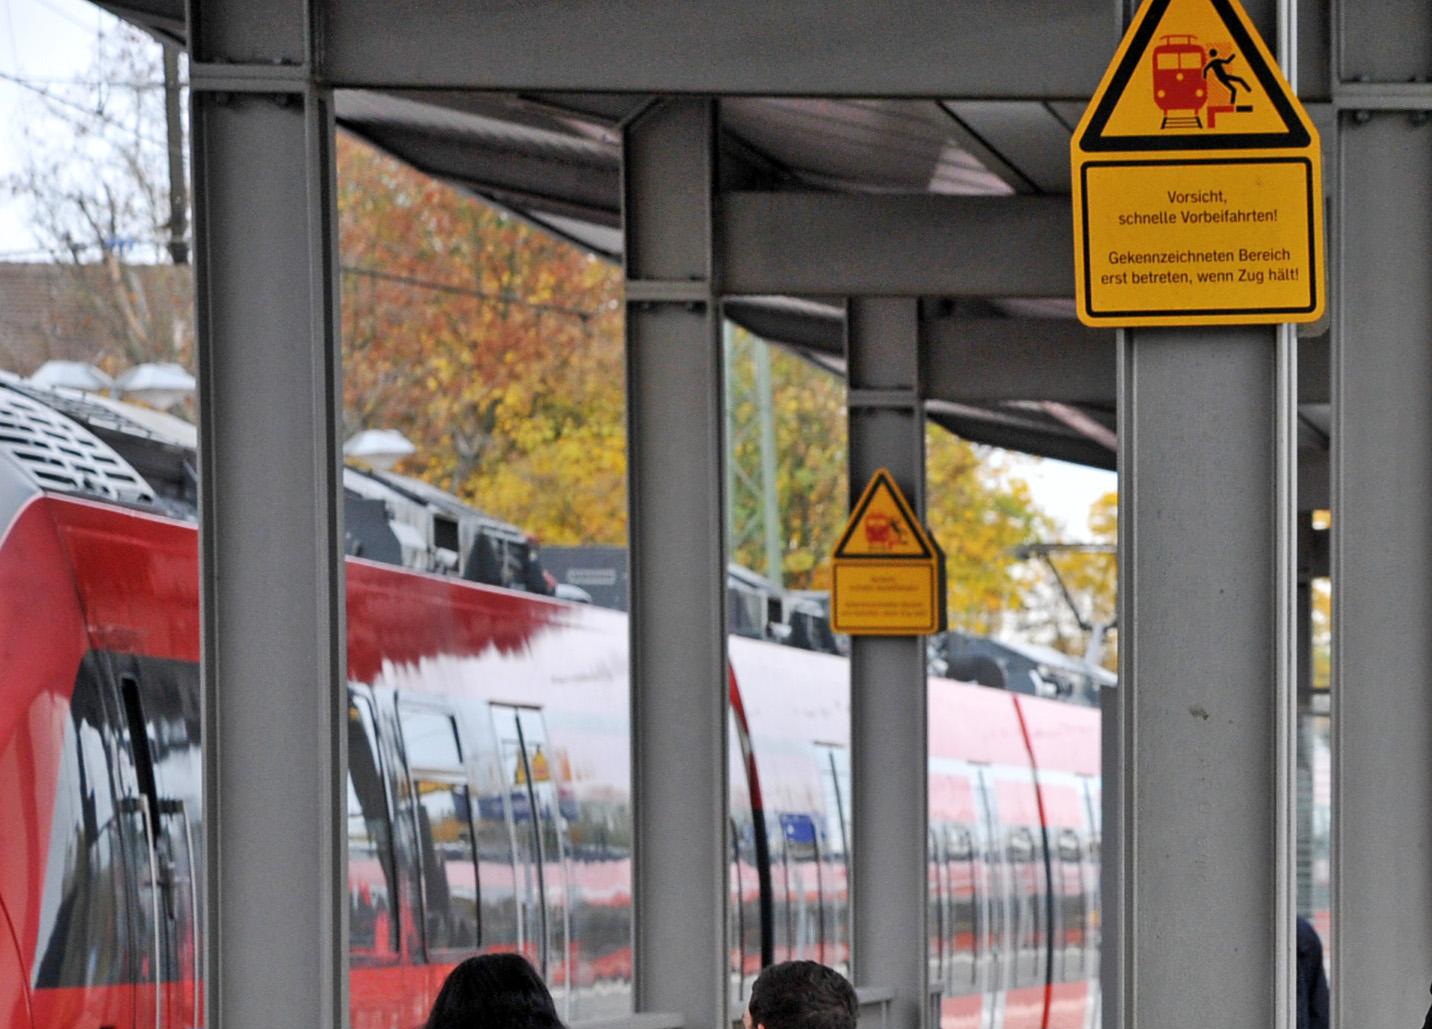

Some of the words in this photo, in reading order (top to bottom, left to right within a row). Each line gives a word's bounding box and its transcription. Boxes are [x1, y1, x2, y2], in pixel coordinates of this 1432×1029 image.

[1168, 189, 1227, 204] Vorsicht,
[1118, 210, 1177, 225] schnelle
[1181, 208, 1278, 223] Vorbeifahrten!
[1108, 249, 1234, 264] Gekennzeichneten
[1238, 248, 1290, 262] Bereich
[1101, 271, 1127, 285] erst
[1131, 271, 1192, 285] betreten,
[1197, 271, 1234, 284] wenn
[1238, 268, 1265, 284] Zug
[1268, 267, 1299, 281] hält!
